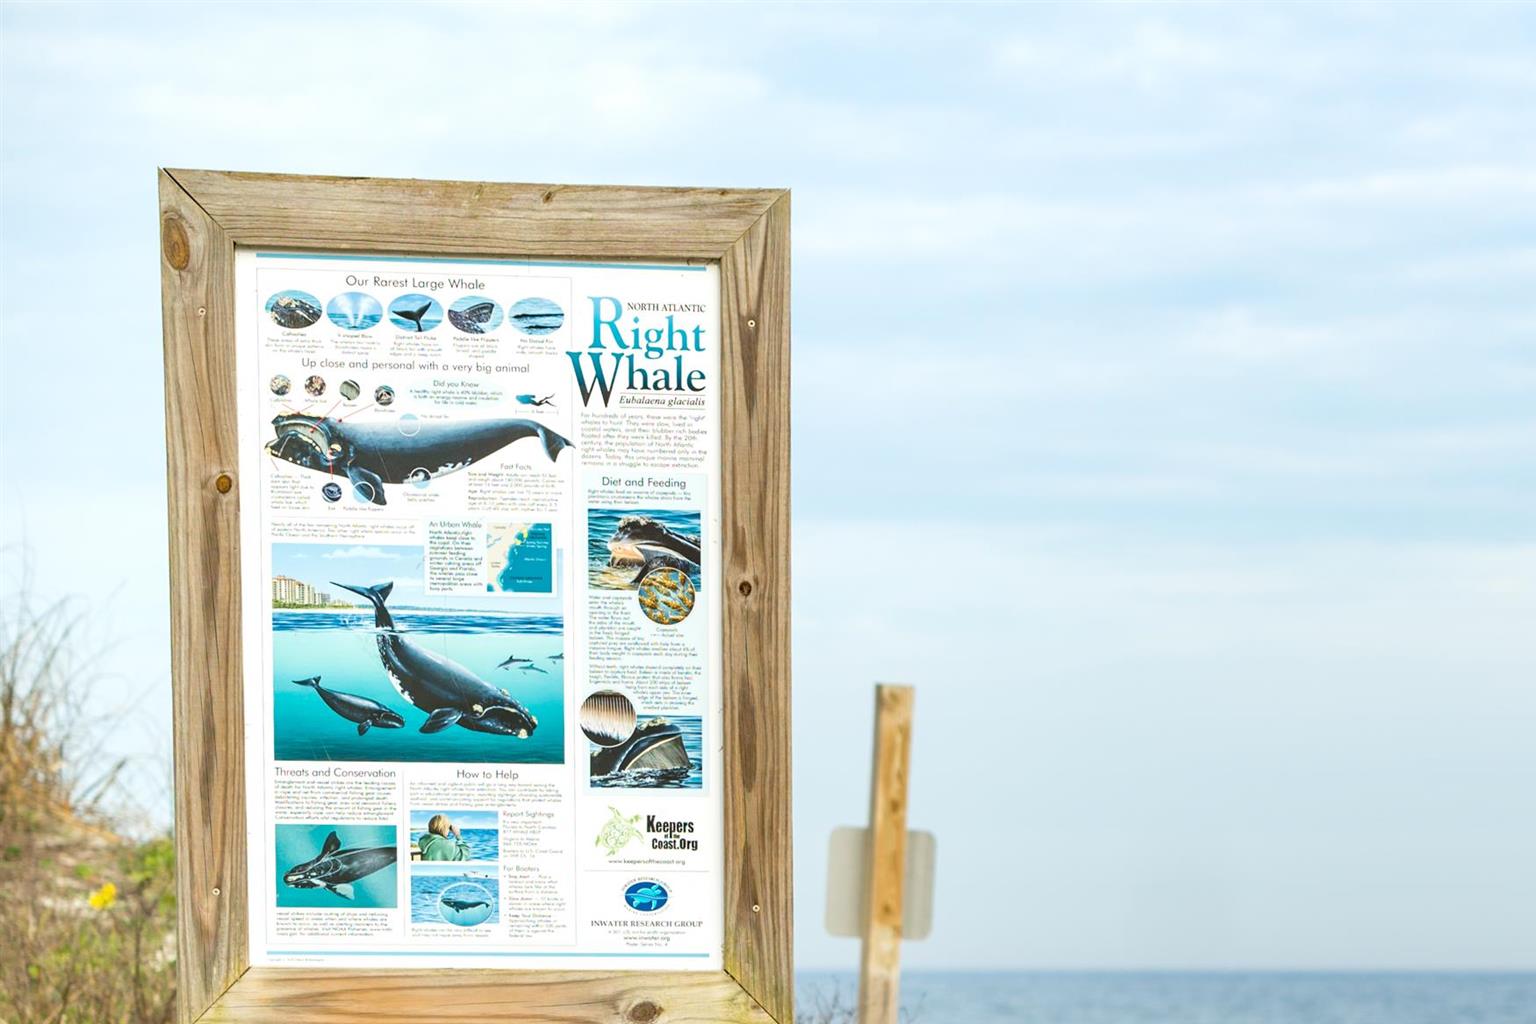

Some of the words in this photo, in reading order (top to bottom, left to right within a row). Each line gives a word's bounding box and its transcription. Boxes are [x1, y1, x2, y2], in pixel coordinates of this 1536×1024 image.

[346, 275, 368, 287] Our
[373, 275, 408, 288] Rarest
[412, 277, 444, 293] Large
[448, 278, 485, 290] Whale
[627, 302, 659, 313] NORTH
[662, 302, 706, 313] ATLANTIC
[587, 296, 706, 360] Right
[301, 359, 317, 372] Up
[319, 359, 346, 370] close
[348, 360, 369, 370] and
[371, 360, 416, 374] personal
[418, 361, 439, 372] with
[441, 364, 449, 372] a
[452, 365, 473, 375] very
[475, 362, 492, 375] big
[495, 363, 530, 373] animal
[566, 351, 706, 408] Whale
[619, 395, 666, 406] Eubalaena
[668, 396, 705, 409] glacialis
[602, 476, 622, 486] Diet
[624, 477, 645, 486] and
[647, 477, 686, 490] Feeding
[275, 767, 310, 777] Threats
[311, 767, 331, 777] and
[333, 768, 396, 778] Conservation
[457, 769, 479, 779] How
[482, 770, 492, 779] to
[495, 770, 519, 782] Help
[525, 811, 554, 819] Sightings
[646, 815, 694, 839] Keepers
[651, 838, 698, 851] Coast.Org
